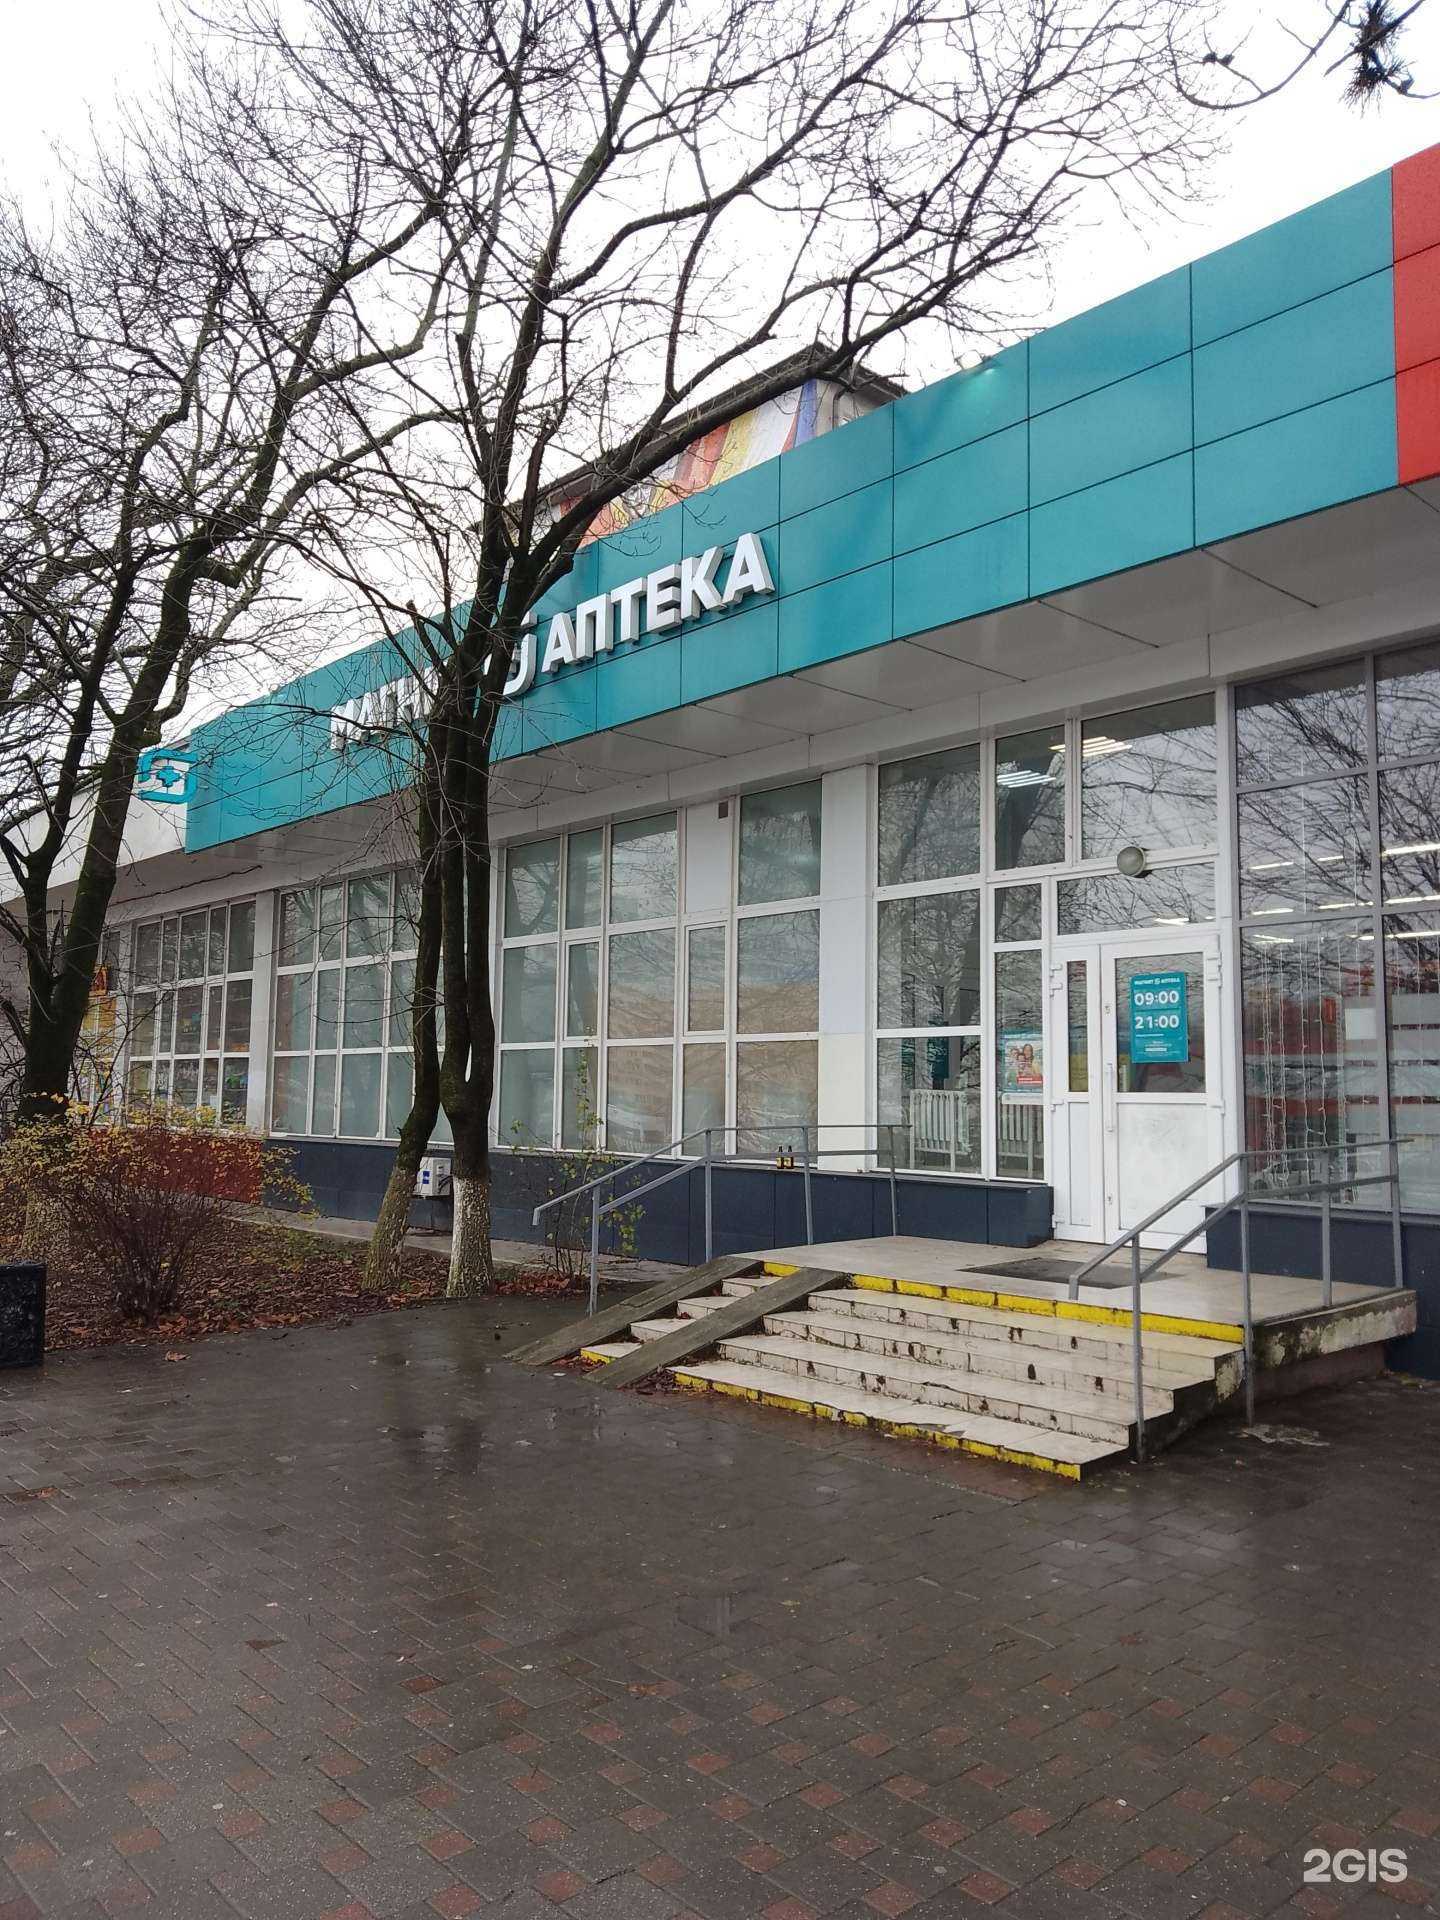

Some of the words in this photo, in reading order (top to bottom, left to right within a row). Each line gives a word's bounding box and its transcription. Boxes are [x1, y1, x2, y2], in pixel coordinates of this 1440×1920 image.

[541, 532, 775, 673] АПТЕКА
[1134, 990, 1180, 1006] 09:00
[1134, 1014, 1180, 1030] 21:00
